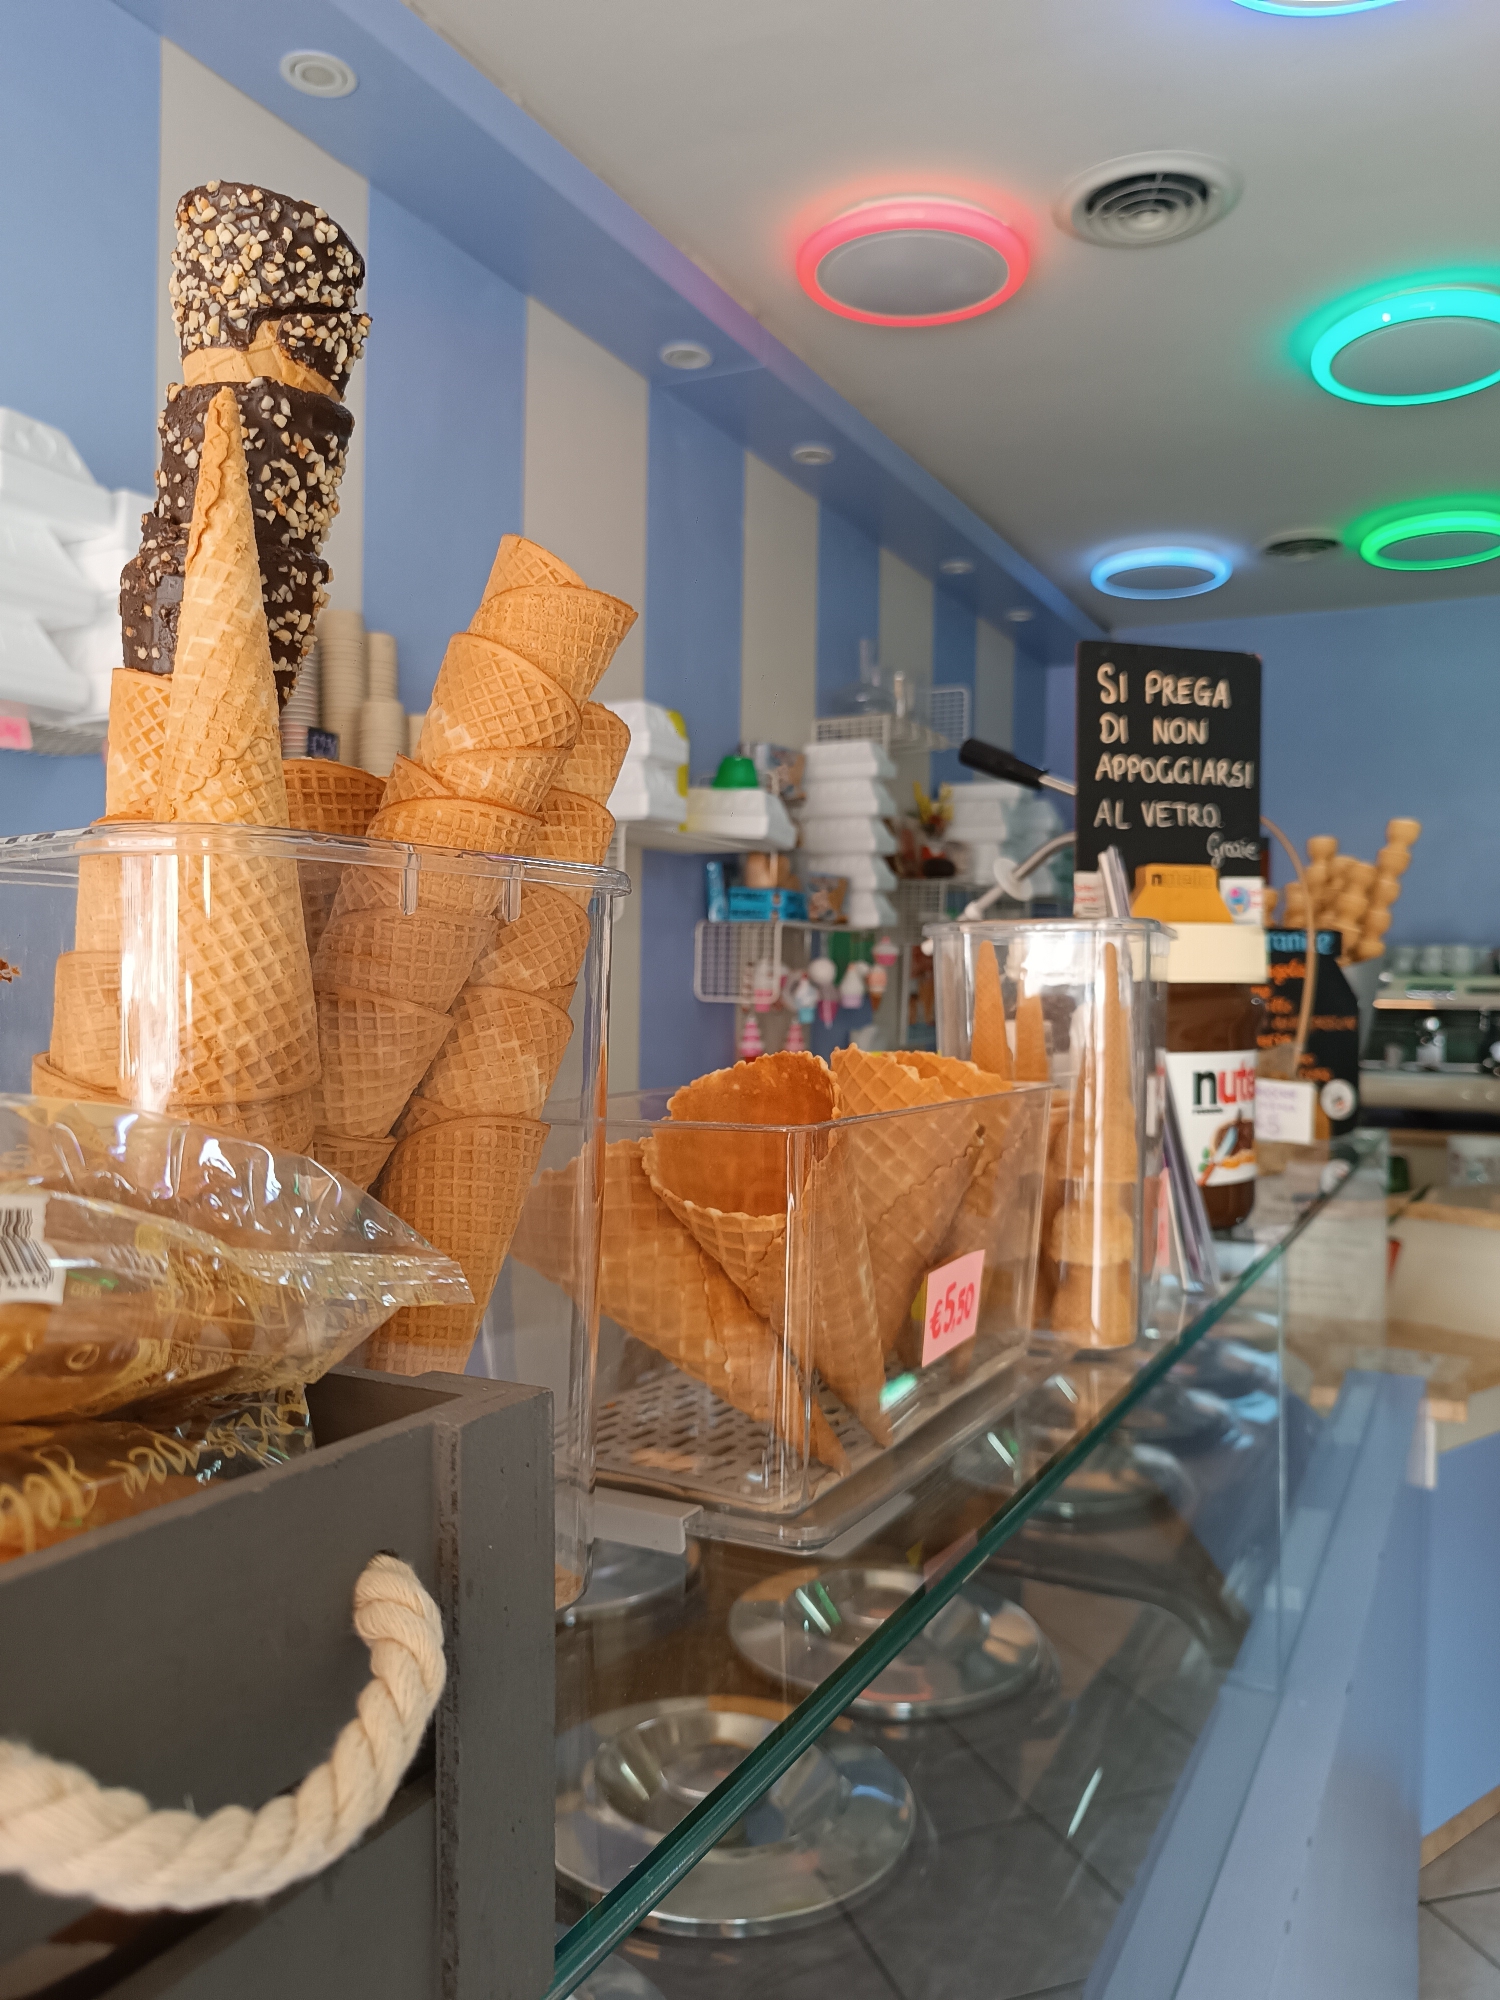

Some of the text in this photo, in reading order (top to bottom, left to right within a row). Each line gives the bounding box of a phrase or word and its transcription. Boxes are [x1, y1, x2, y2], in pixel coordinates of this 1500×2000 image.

[1098, 662, 1232, 709] SI PREGA
[1099, 712, 1209, 745] DI NON
[1095, 751, 1255, 789] APPOGGIARSI
[1093, 799, 1221, 829] AL VETRO
